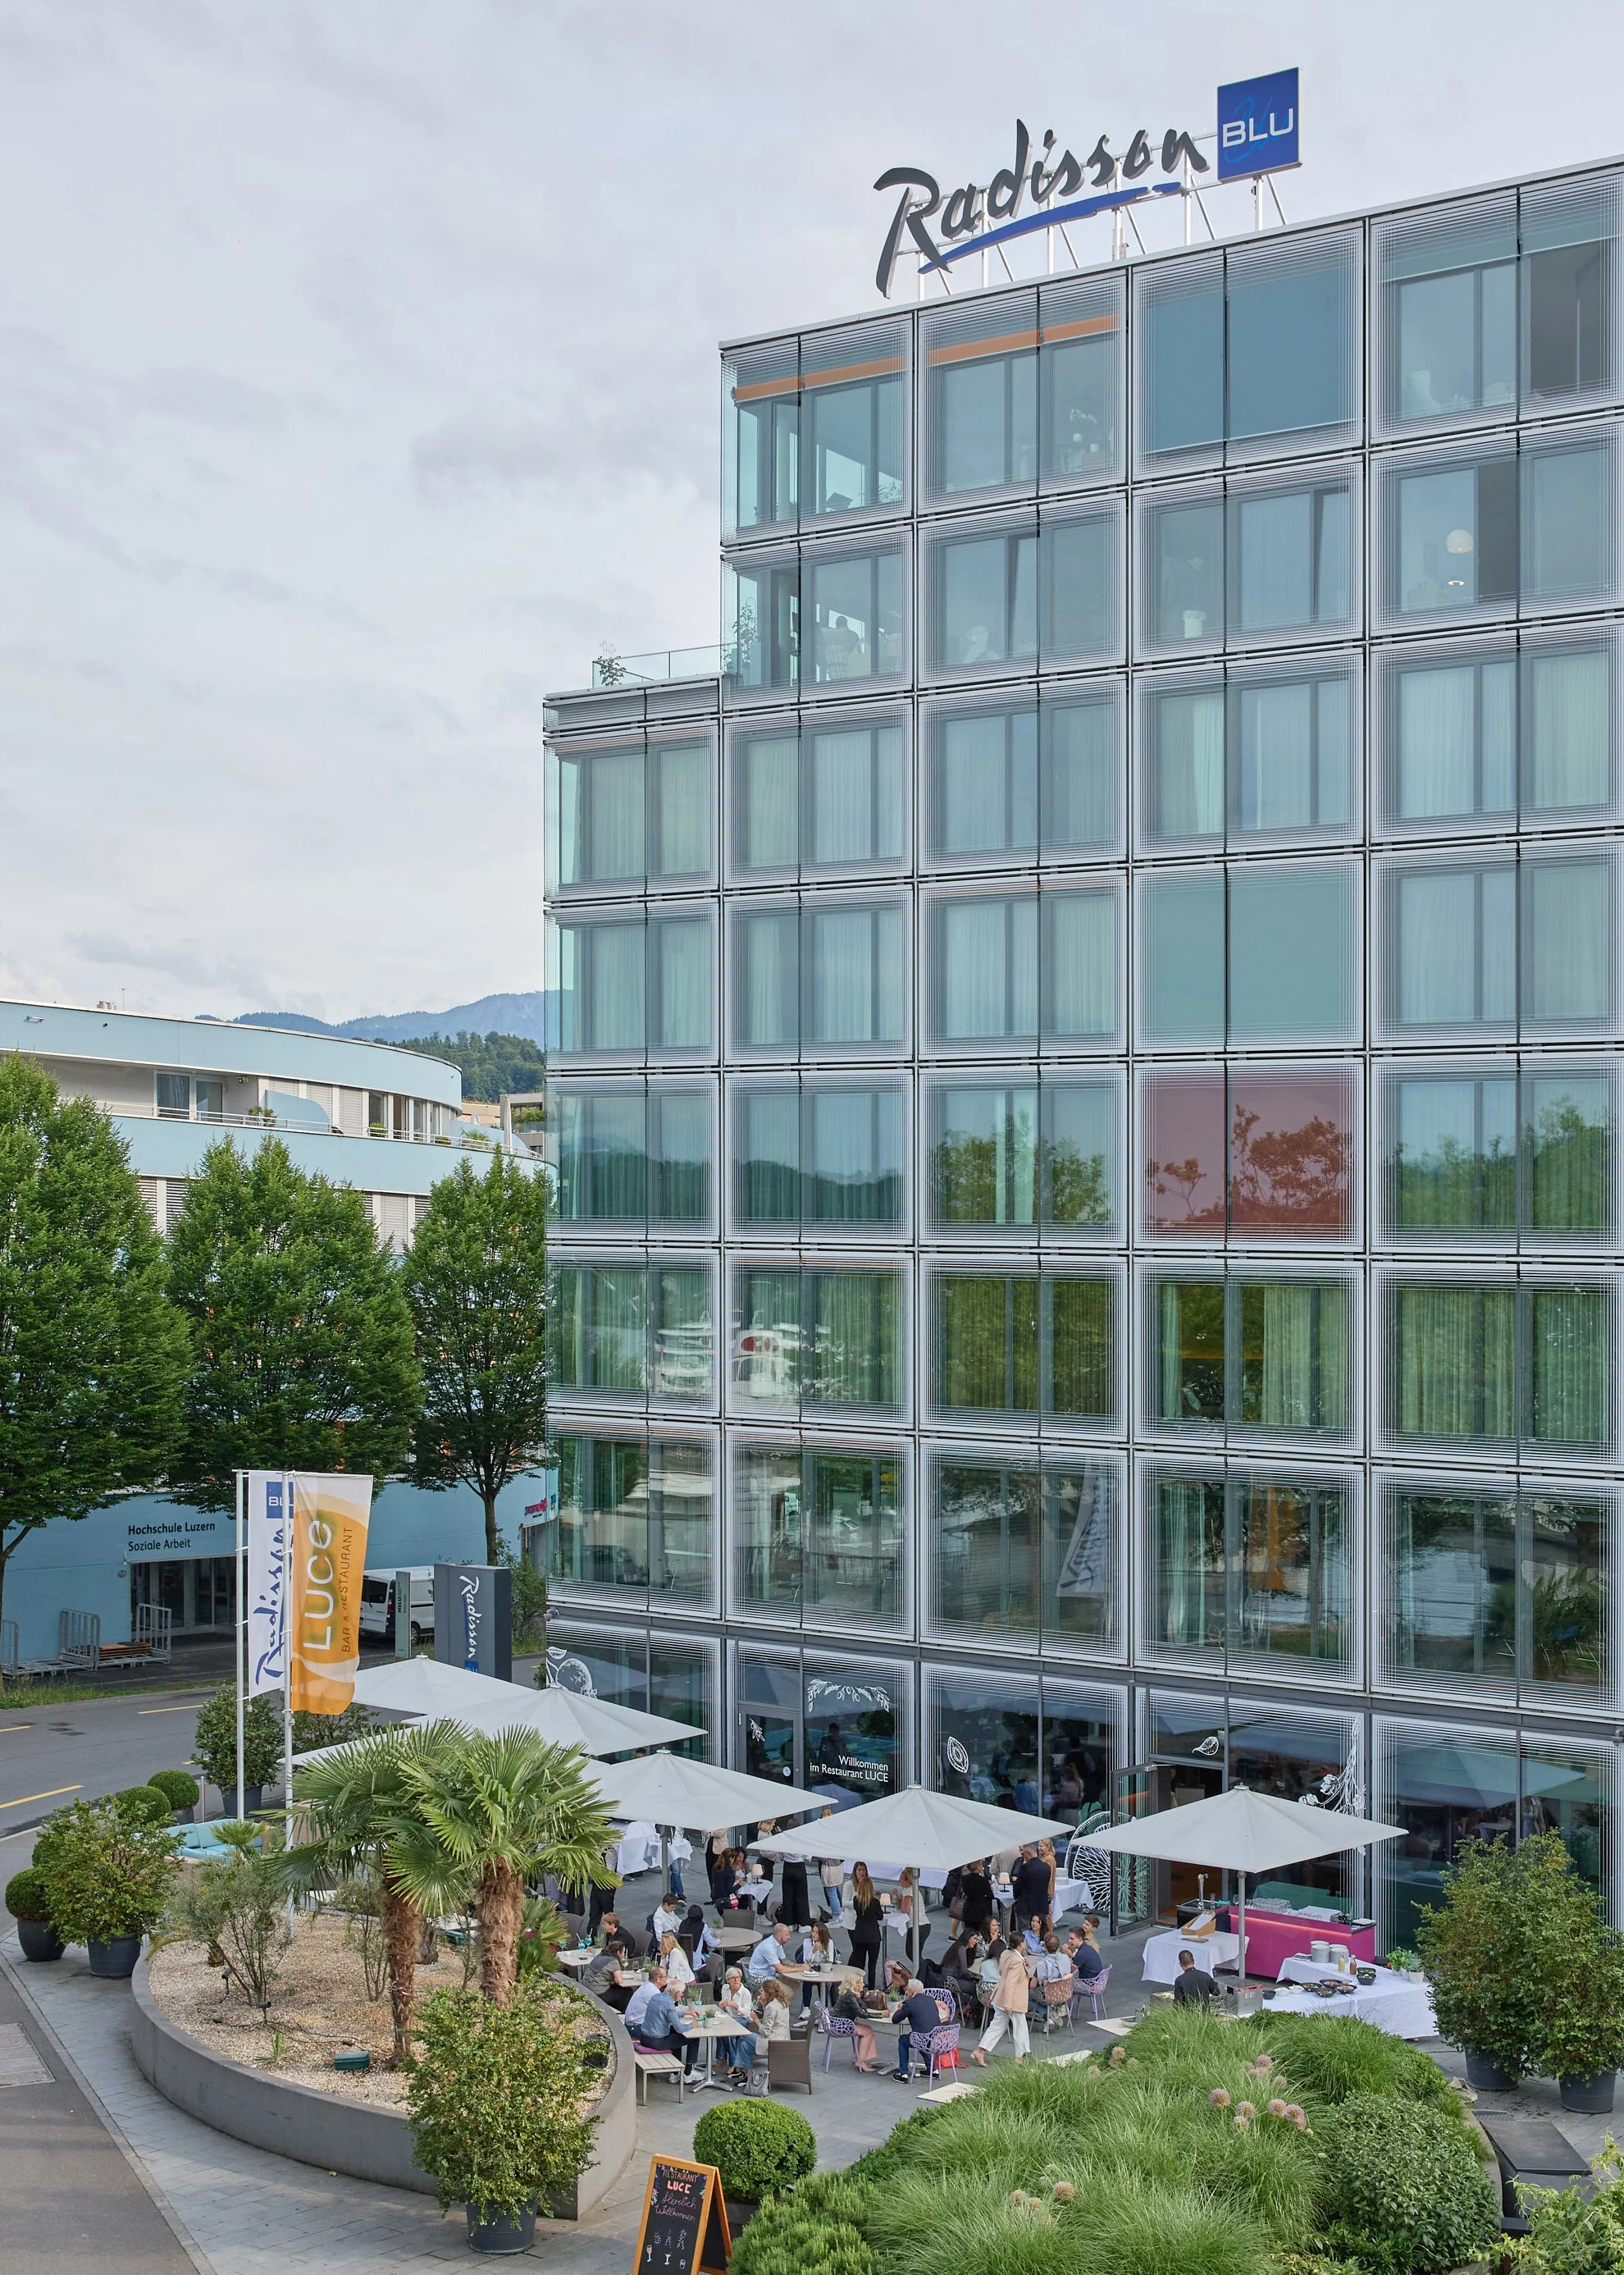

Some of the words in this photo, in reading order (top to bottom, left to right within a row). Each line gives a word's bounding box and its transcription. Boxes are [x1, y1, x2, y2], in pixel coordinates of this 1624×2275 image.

[874, 118, 1210, 299] Radisson
[1222, 107, 1293, 148] BLU
[128, 1523, 182, 1536] Hochschule
[185, 1522, 215, 1533] Luzern
[128, 1540, 161, 1552] Soziale
[163, 1538, 191, 1550] Arbeit
[459, 1575, 483, 1658] Radisson
[341, 1627, 350, 1652] BAR
[838, 1755, 888, 1771] Willkommen
[810, 1762, 819, 1772] im
[821, 1764, 864, 1779] Restaurant
[864, 1770, 889, 1783] LUCE
[663, 2169, 698, 2183] RESTAURANT
[667, 2180, 691, 2194] LUCE
